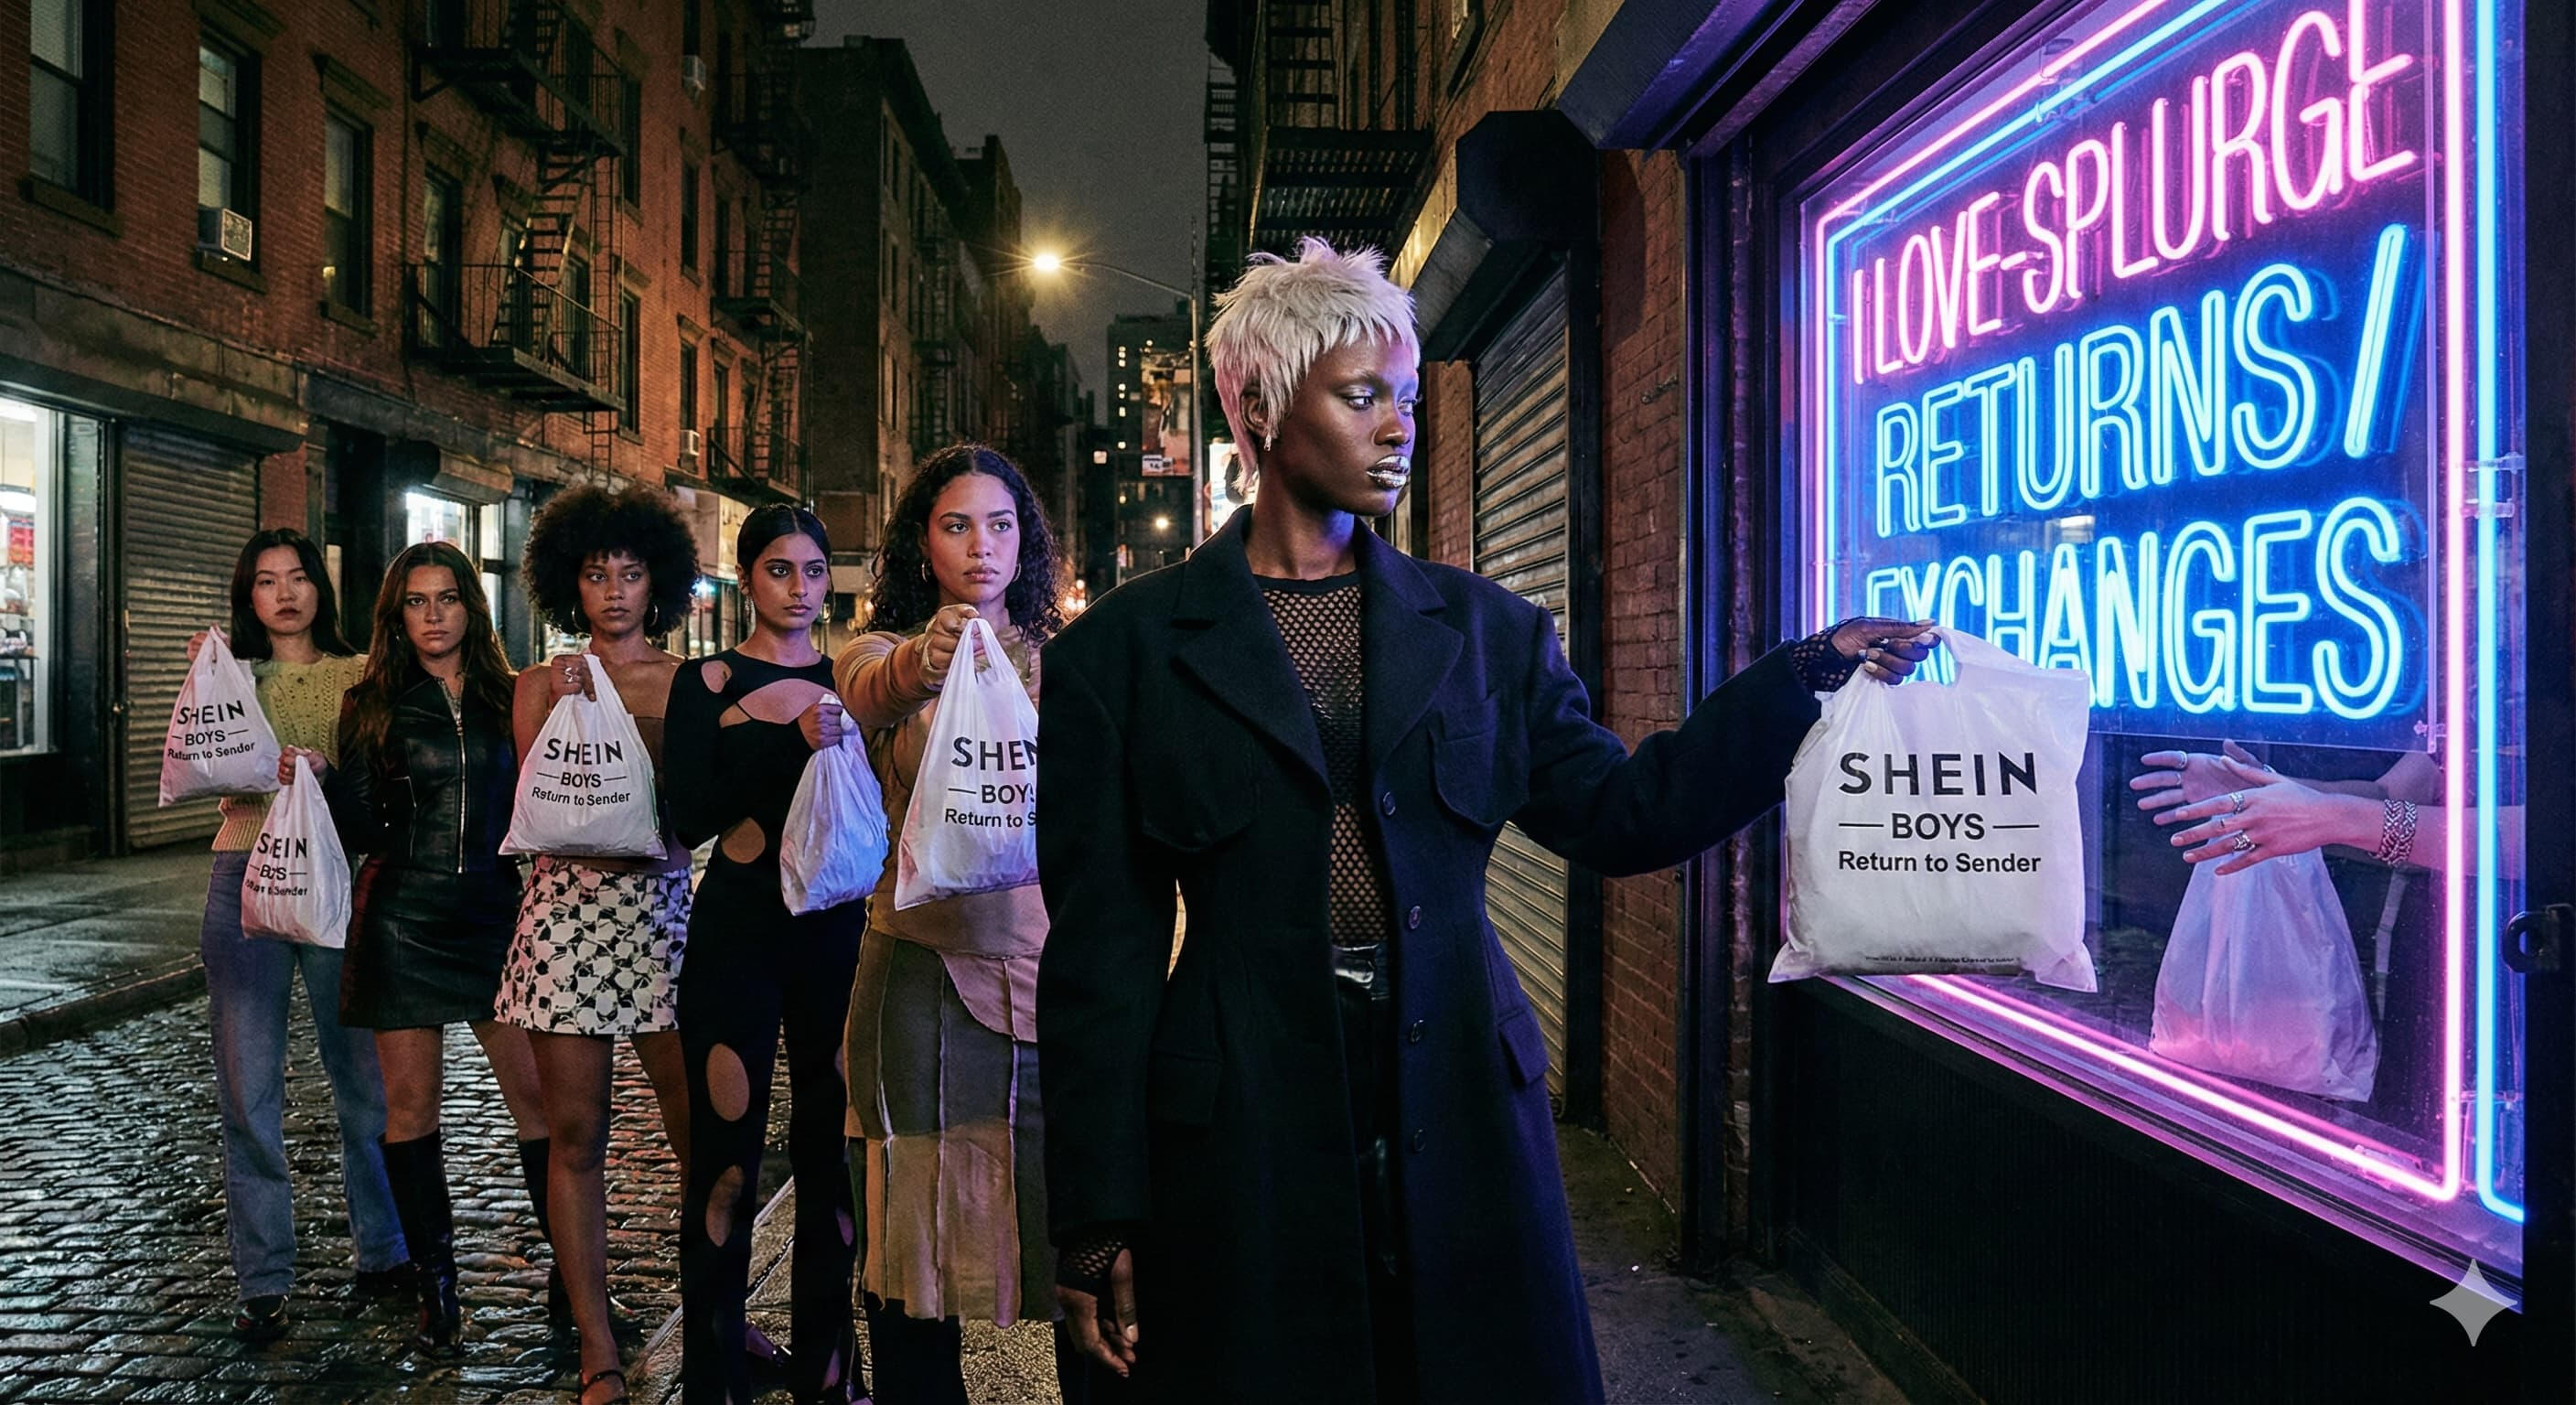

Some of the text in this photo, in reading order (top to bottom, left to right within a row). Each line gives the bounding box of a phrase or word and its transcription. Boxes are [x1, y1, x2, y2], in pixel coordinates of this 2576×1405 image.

[1876, 263, 2316, 538] RETURNS
[177, 700, 245, 724] SHEIN
[185, 730, 226, 745] BOYS
[543, 737, 623, 765] SHEIN
[560, 771, 602, 788] BOYS
[1839, 751, 2037, 796] SHEIN
[574, 794, 585, 806] to
[586, 792, 630, 806] Sender
[945, 808, 1002, 827] Return
[1006, 814, 1023, 828] to
[1892, 812, 1985, 841] BOYS
[257, 832, 307, 859] SEIN
[1839, 850, 2041, 873] Return to Sender
